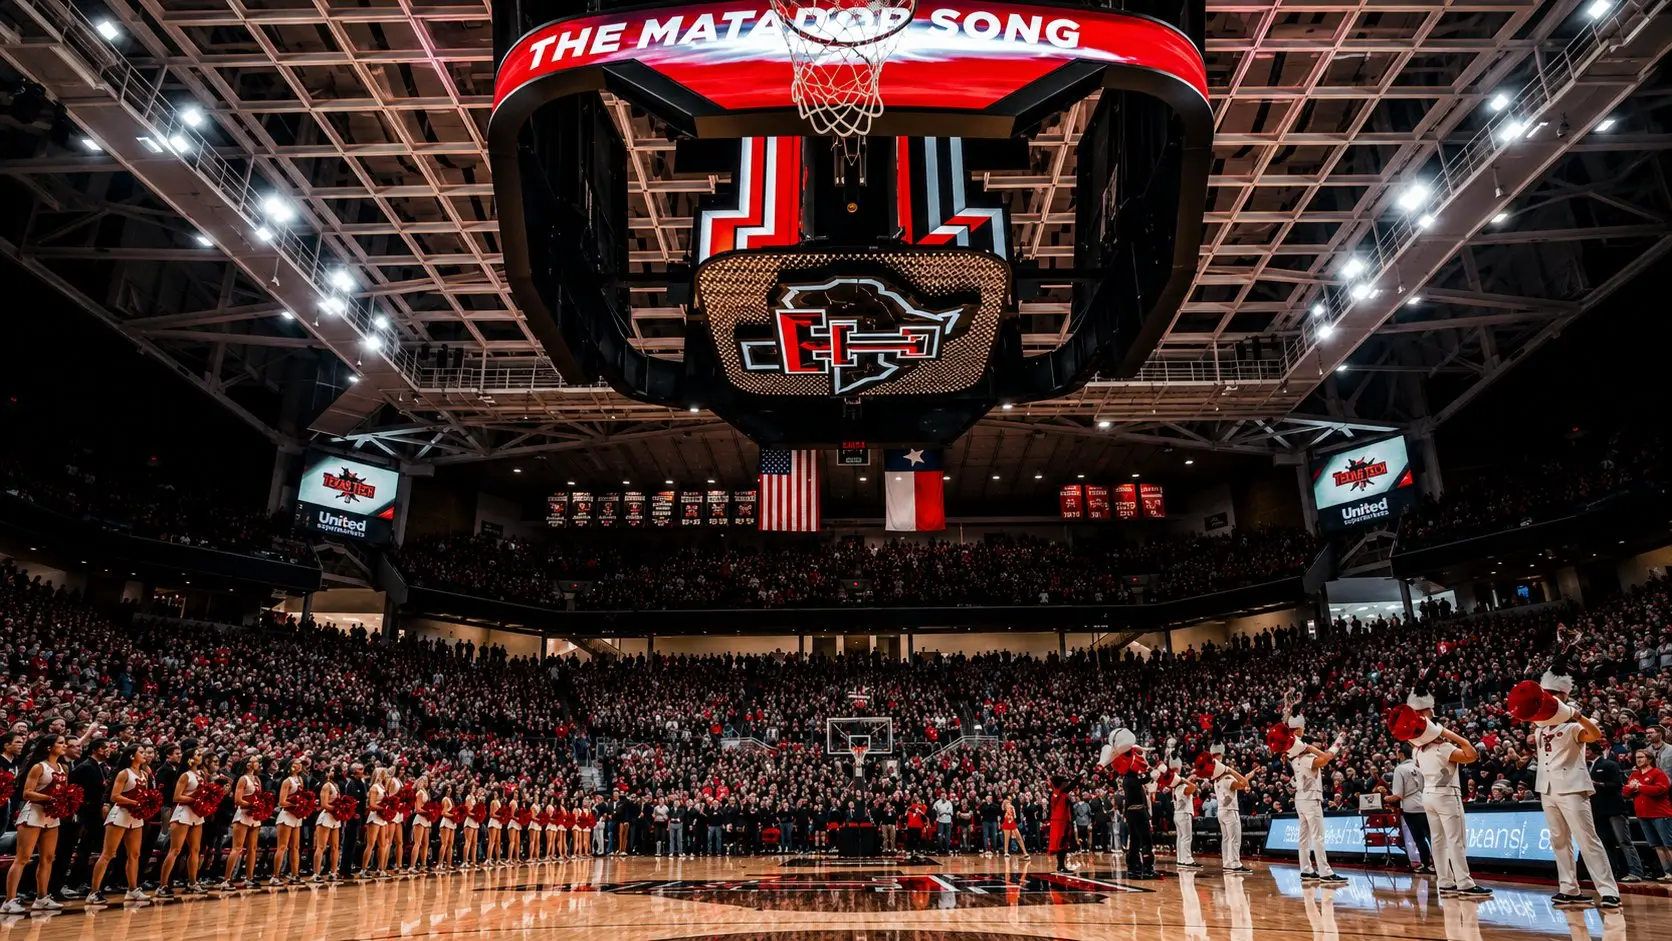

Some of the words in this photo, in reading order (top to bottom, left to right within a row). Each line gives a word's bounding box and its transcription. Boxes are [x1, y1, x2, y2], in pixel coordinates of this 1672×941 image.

[530, 22, 627, 71] THE
[636, 7, 912, 49] MATADOR
[927, 8, 1081, 48] SONG
[1342, 497, 1388, 519] United
[319, 511, 367, 532] United
